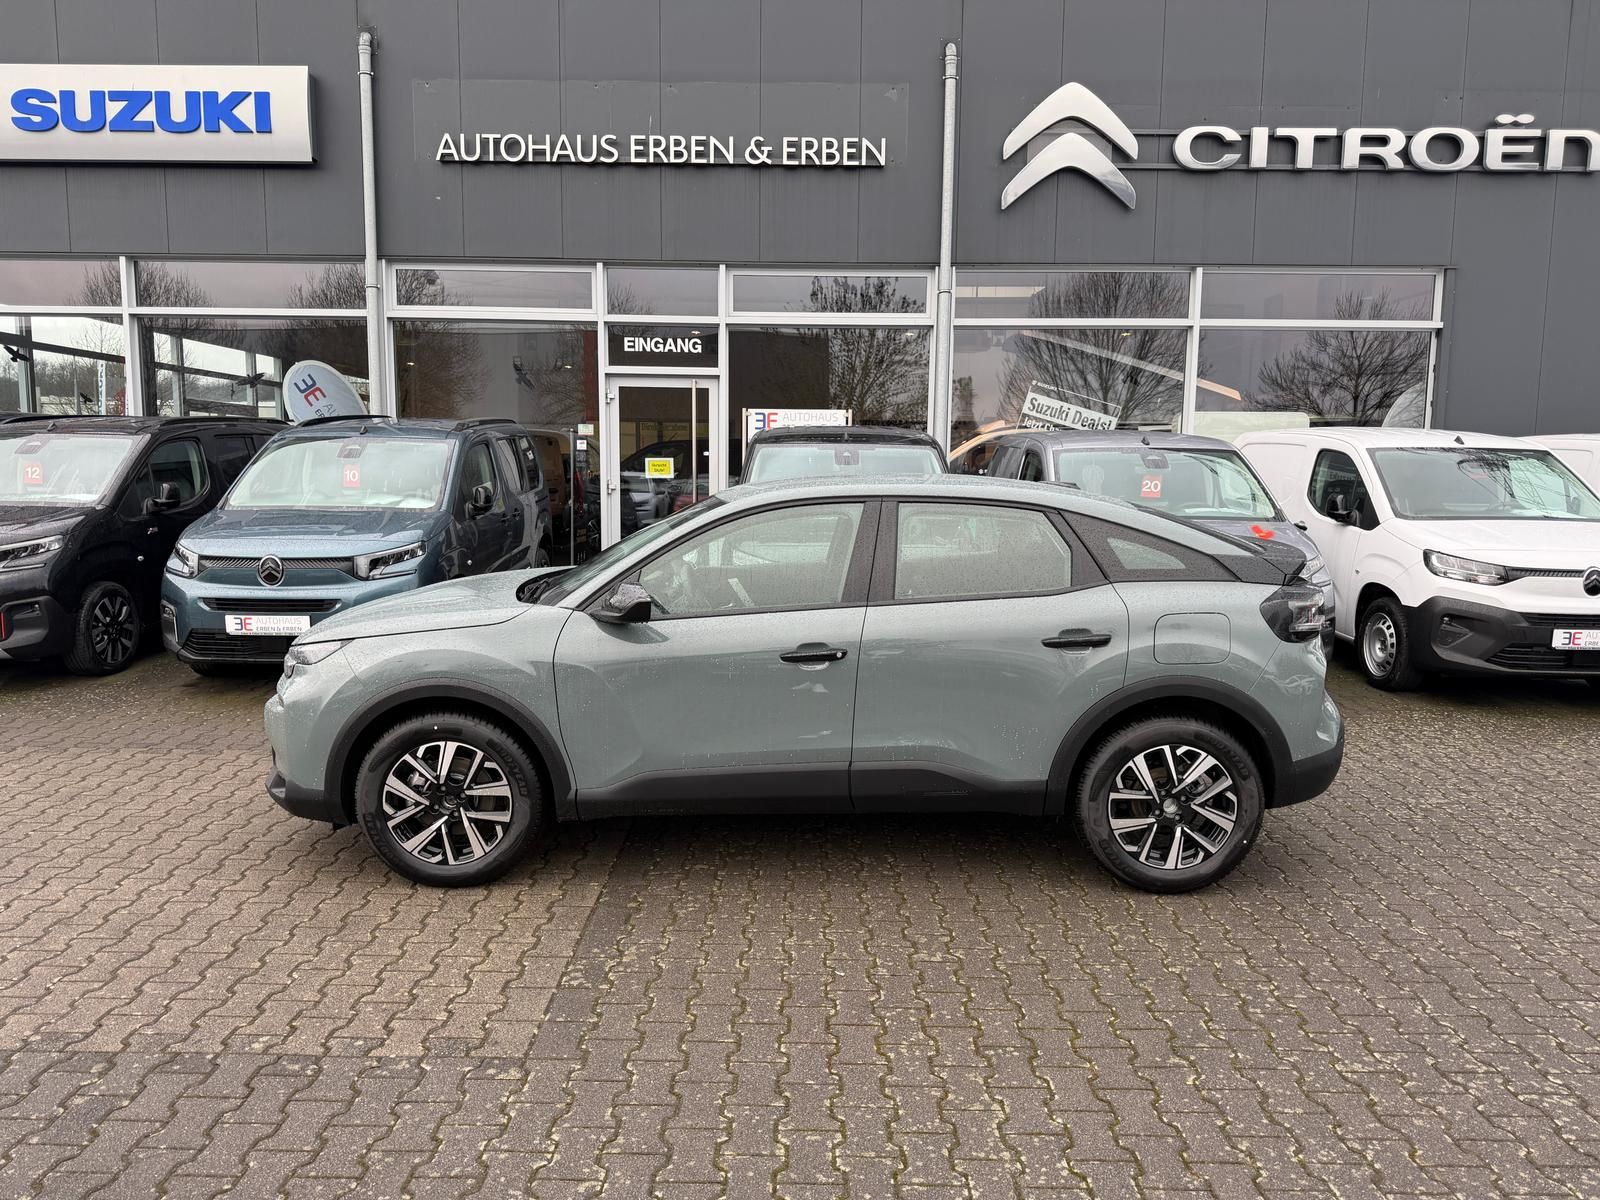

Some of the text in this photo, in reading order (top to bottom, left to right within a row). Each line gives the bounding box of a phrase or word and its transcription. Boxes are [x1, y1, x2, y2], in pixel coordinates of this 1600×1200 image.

[11, 88, 273, 134] SUZUKI
[436, 132, 887, 167] AUTOHAUS ERBEN & ERBEN
[623, 336, 702, 354] EINGANG
[1027, 397, 1070, 422] Suzuki
[783, 412, 840, 423] AUTOHAUS
[25, 466, 41, 479] 12
[344, 469, 359, 482] 10
[1141, 479, 1161, 493] 20
[256, 617, 303, 625] AUTOHAUS
